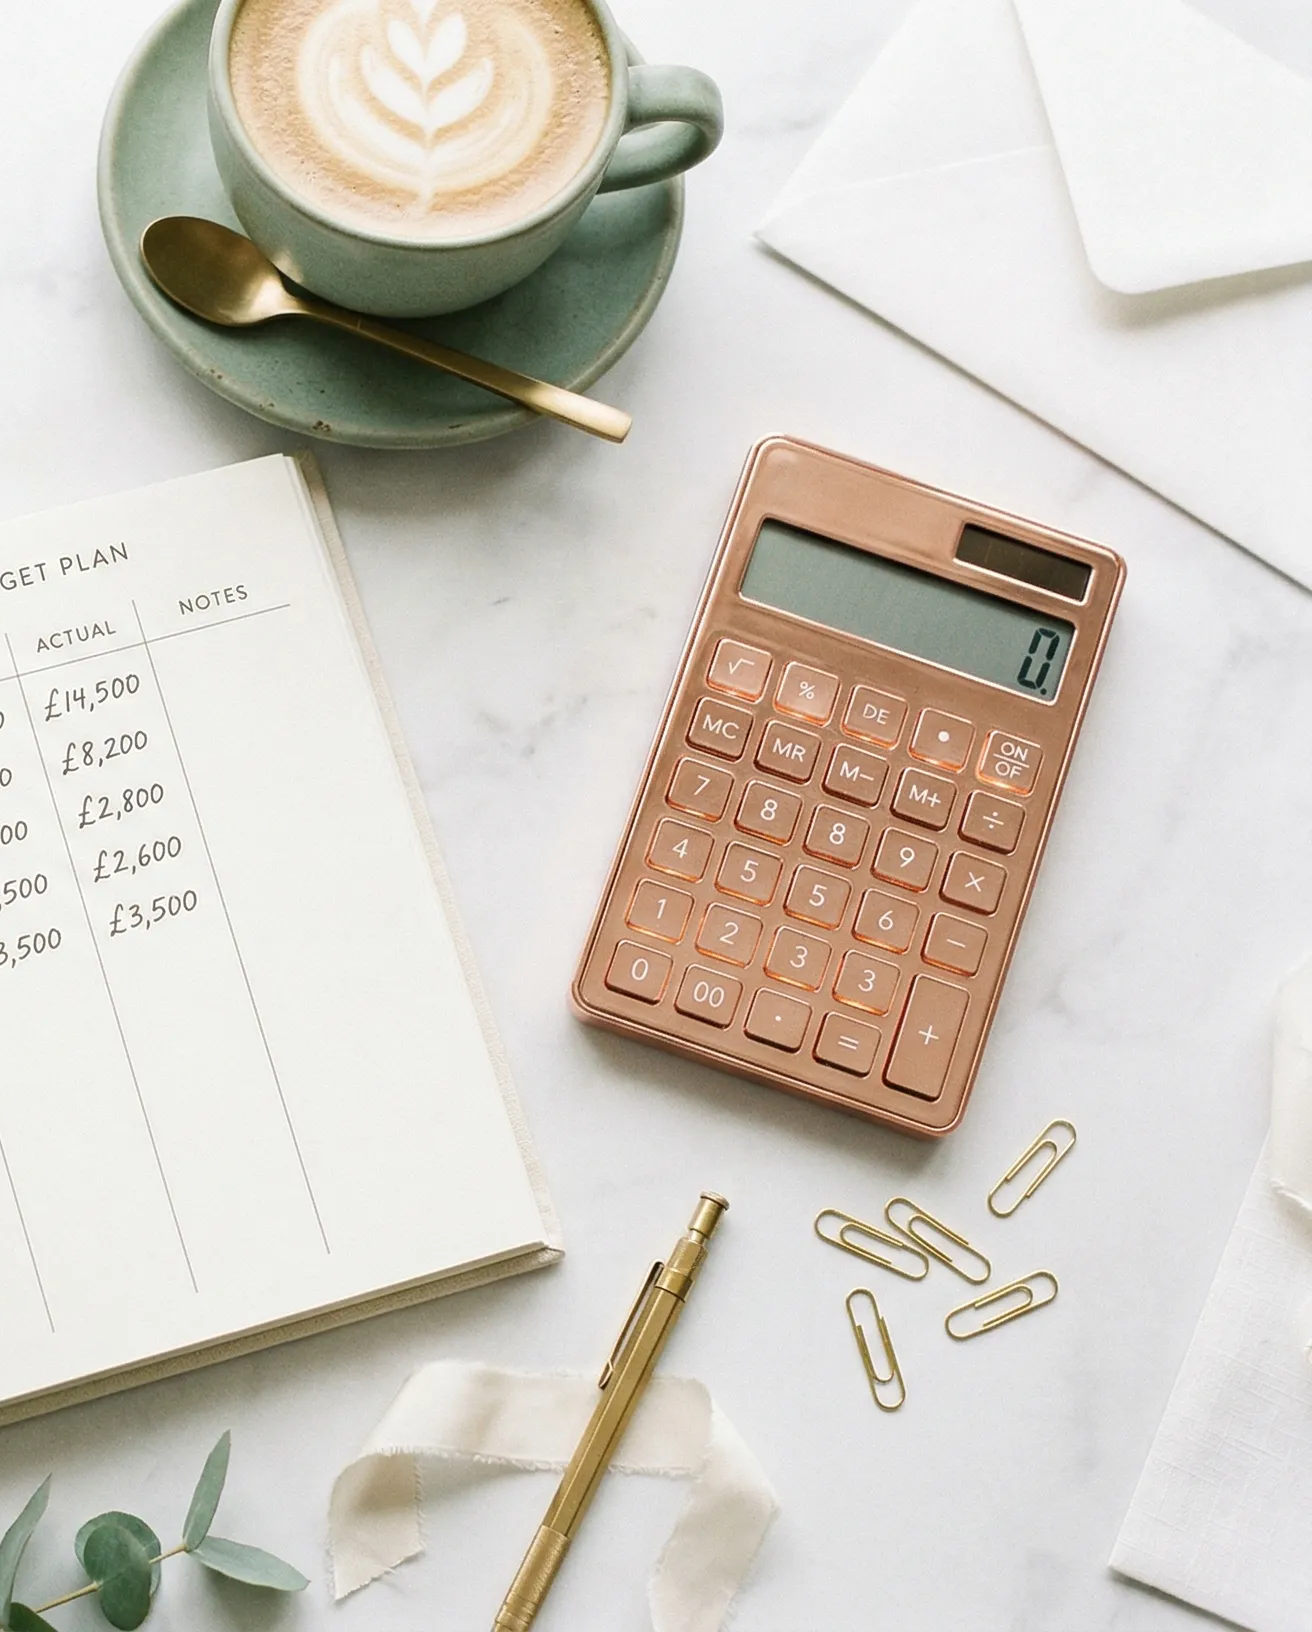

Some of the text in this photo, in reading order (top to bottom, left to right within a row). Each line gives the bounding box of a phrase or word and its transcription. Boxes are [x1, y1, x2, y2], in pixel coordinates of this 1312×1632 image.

[60, 542, 128, 575] PLAN
[37, 621, 116, 653] ACTUAL
[179, 585, 247, 615] NOTES
[45, 674, 139, 722] £14,500
[798, 681, 815, 700] %
[863, 704, 889, 724] DE
[703, 715, 739, 739] MC
[62, 731, 147, 775] £8,200
[773, 739, 805, 762] MR
[1000, 742, 1029, 762] ON
[995, 761, 1023, 779] OF
[695, 775, 710, 795] 7
[78, 783, 163, 829] £2,800
[909, 785, 940, 807] M+
[761, 800, 777, 820] 8
[830, 823, 845, 844] 8
[673, 839, 688, 858] 4
[900, 848, 914, 867] 9
[93, 836, 181, 883] £2,600
[741, 860, 758, 882] 5
[810, 885, 827, 906] 5
[110, 890, 197, 937] £3,500
[658, 899, 666, 918] 1
[879, 911, 893, 930] 6
[720, 922, 738, 944] 2
[790, 946, 807, 967] 3
[632, 959, 648, 980] 0
[859, 970, 875, 991] 3
[694, 982, 724, 1007] 00
